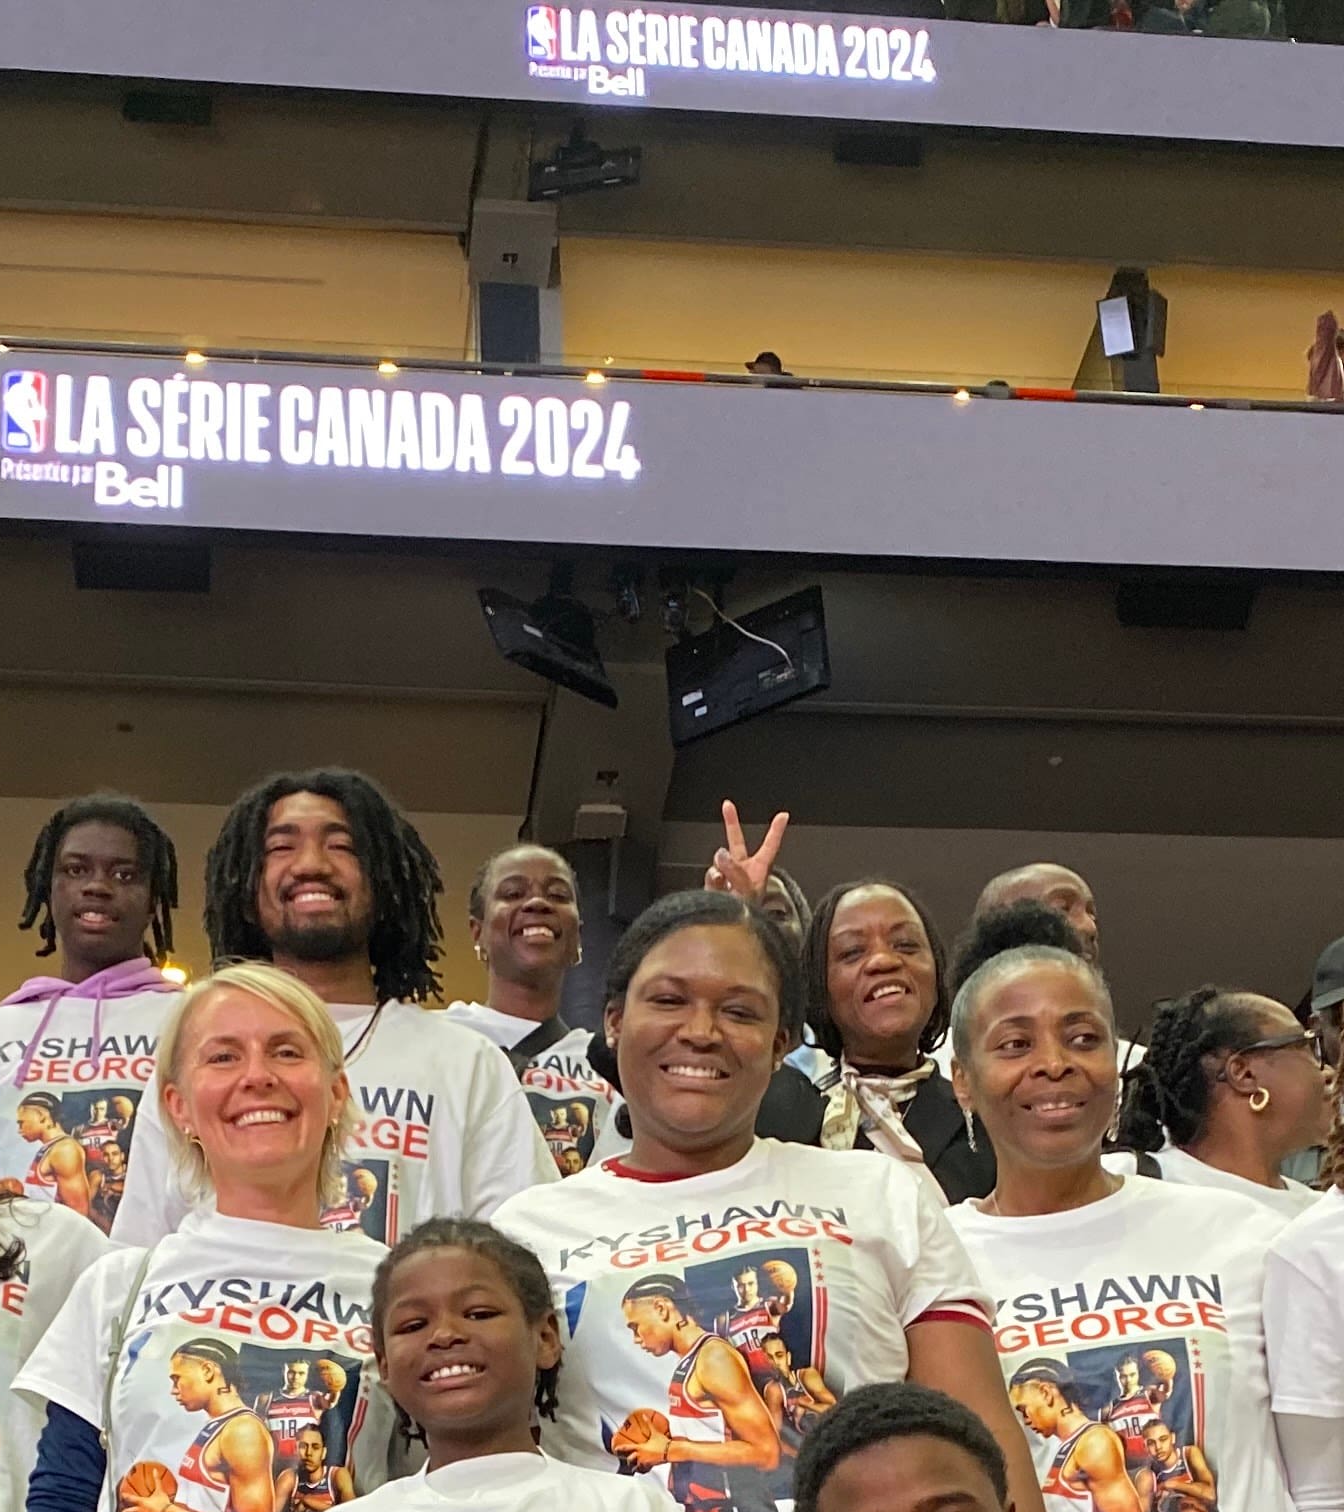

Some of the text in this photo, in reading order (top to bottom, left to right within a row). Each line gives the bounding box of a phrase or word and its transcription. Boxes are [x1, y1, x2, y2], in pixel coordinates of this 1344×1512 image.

[560, 8, 936, 82] LA SÉRIE CANADA 2024
[588, 65, 645, 96] Bell
[55, 373, 642, 480] LA SÉRIE CANADA 2024
[94, 460, 183, 508] Bell
[23, 1057, 156, 1083] GEORG
[559, 1199, 848, 1272] KYSHAWN
[609, 1217, 854, 1269] GEORGE
[992, 1273, 1222, 1328] YSHAWN
[742, 1328, 761, 1352] 18
[994, 1301, 1227, 1354] GEORGE
[279, 1419, 297, 1439] 18
[1123, 1416, 1143, 1437] 18
